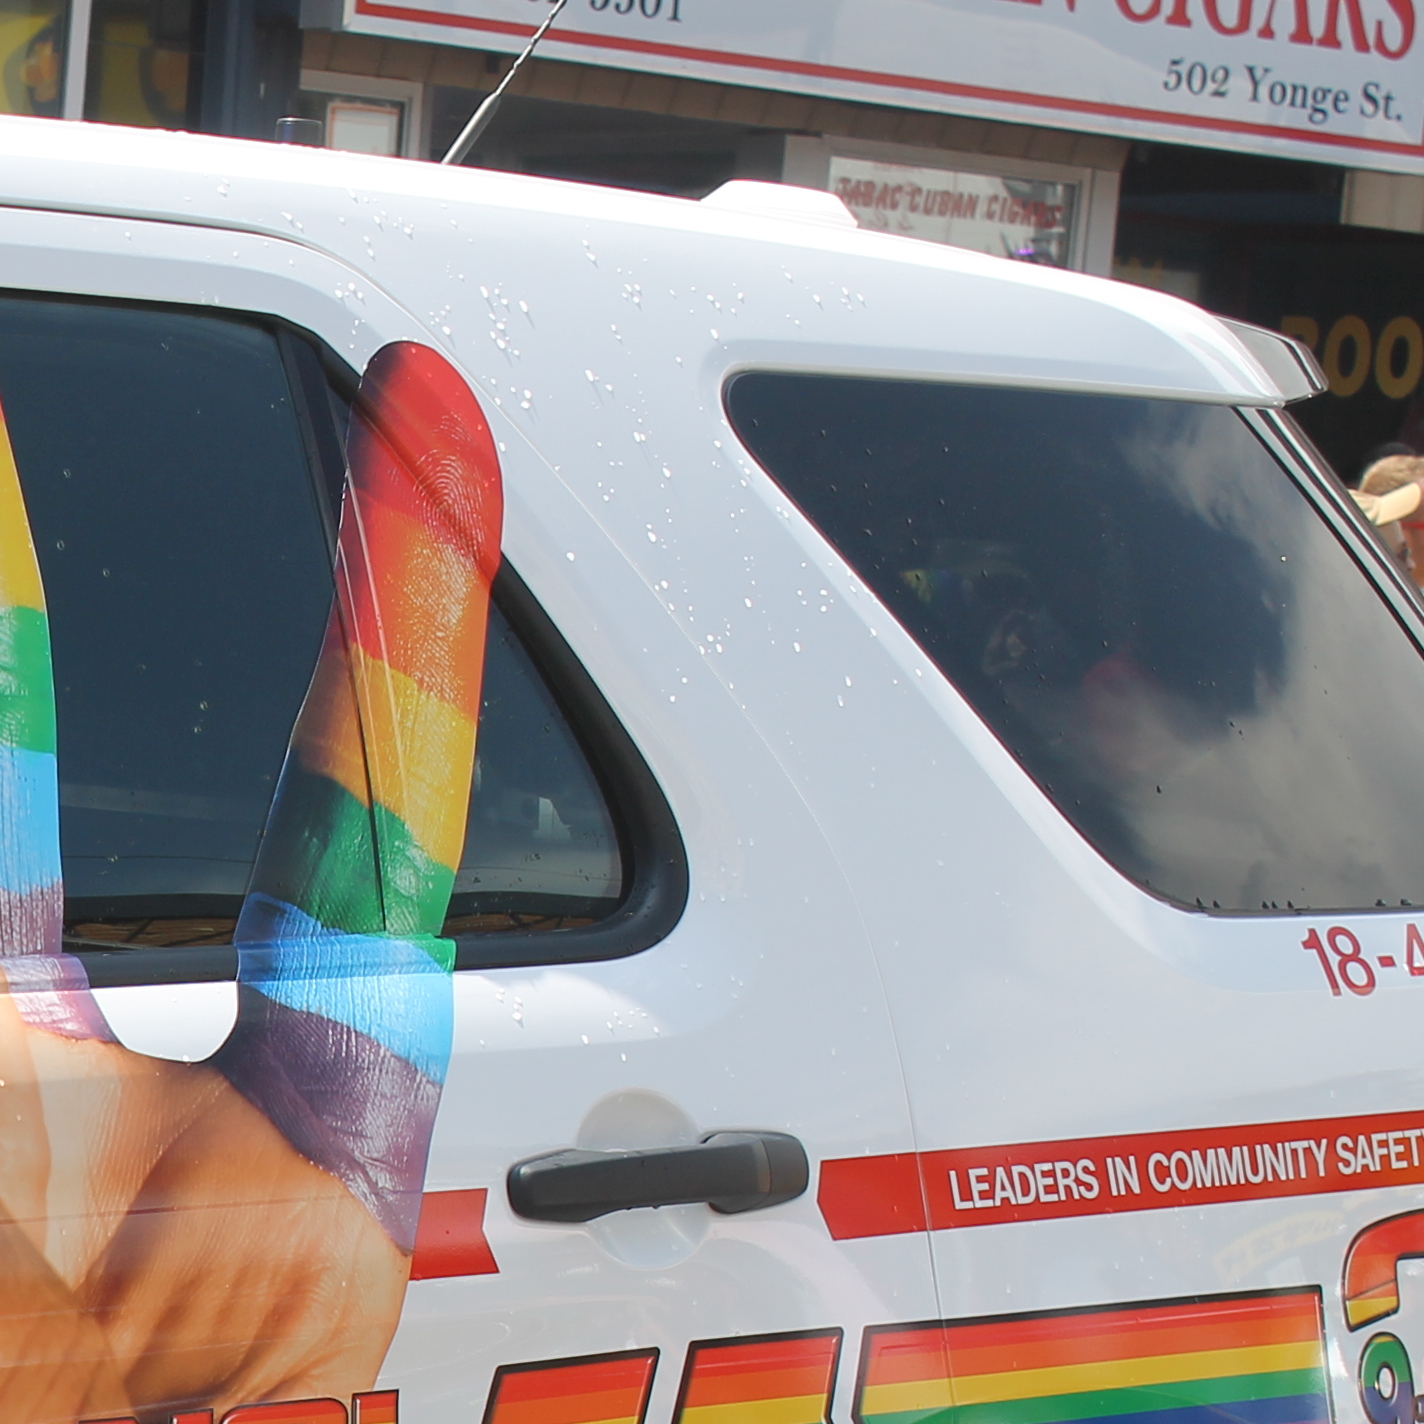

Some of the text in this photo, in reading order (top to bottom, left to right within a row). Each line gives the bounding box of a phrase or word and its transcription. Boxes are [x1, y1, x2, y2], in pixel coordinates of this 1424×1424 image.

[1163, 56, 1403, 124] 502 Yonge St.
[908, 184, 980, 220] CUBAN
[948, 1128, 1424, 1211] LEADERS IN COMMUNITY SAFET
